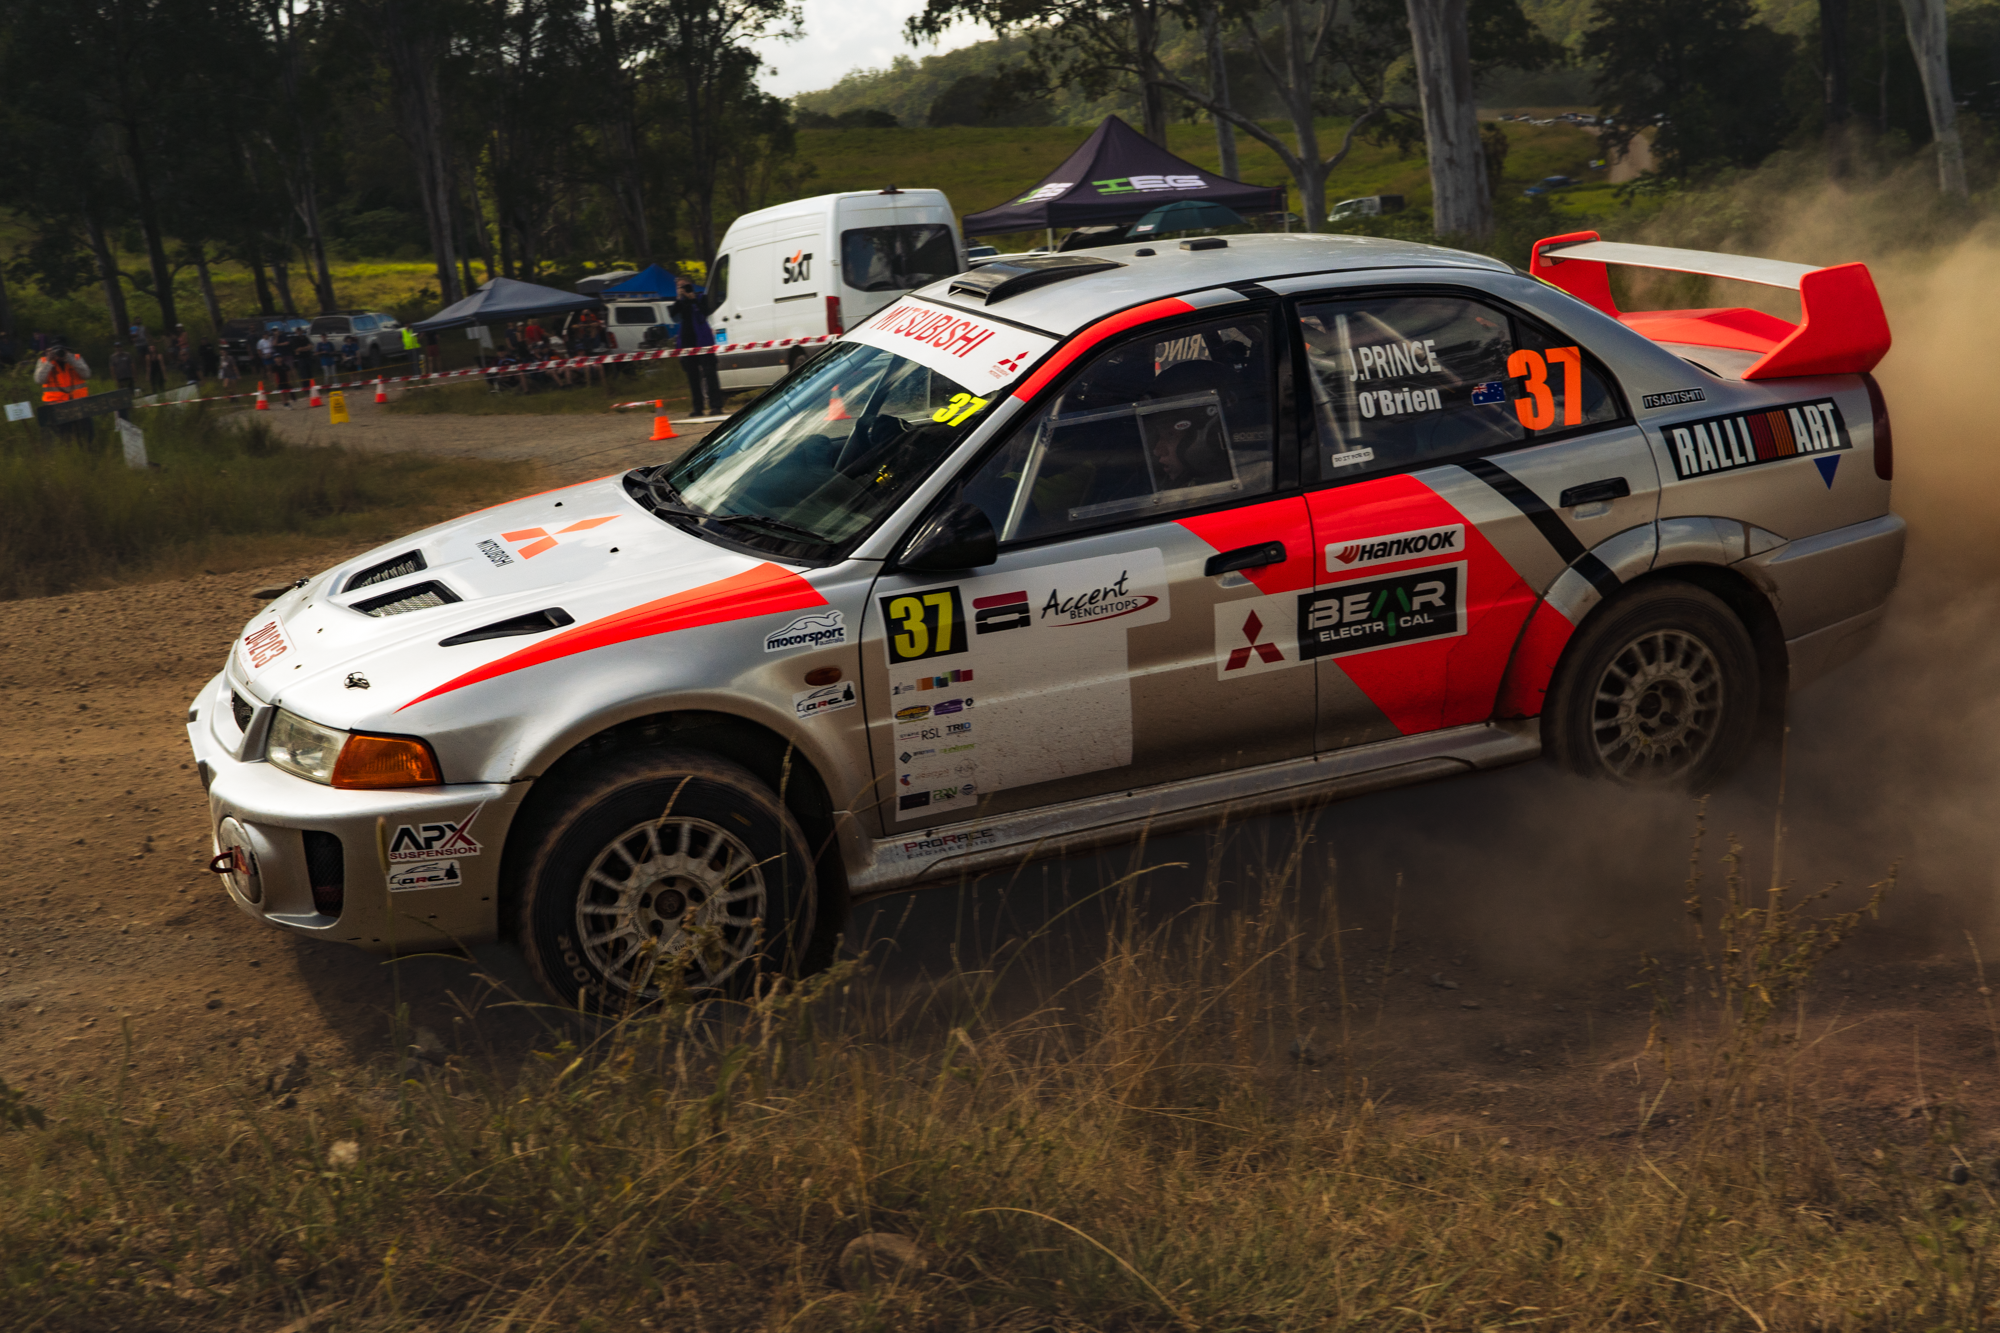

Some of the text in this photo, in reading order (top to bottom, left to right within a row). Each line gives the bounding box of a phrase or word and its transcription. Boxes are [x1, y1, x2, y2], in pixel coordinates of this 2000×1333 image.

[783, 250, 813, 284] SIXT
[869, 305, 996, 358] MITSUBISHI
[1349, 340, 1442, 382] J.PRINCE
[1359, 387, 1442, 418] O'Brien
[1507, 346, 1582, 431] 37
[932, 392, 989, 427] 37
[1672, 402, 1841, 476] RALLI ART
[1041, 570, 1129, 619] Accent
[1070, 598, 1138, 620] BENCHTOPS
[767, 627, 844, 650] motorsport
[889, 591, 953, 658] 37
[921, 728, 942, 740] RSL
[946, 722, 971, 732] TRIO
[390, 809, 478, 852] APX
[389, 846, 478, 860] SUSPENSION
